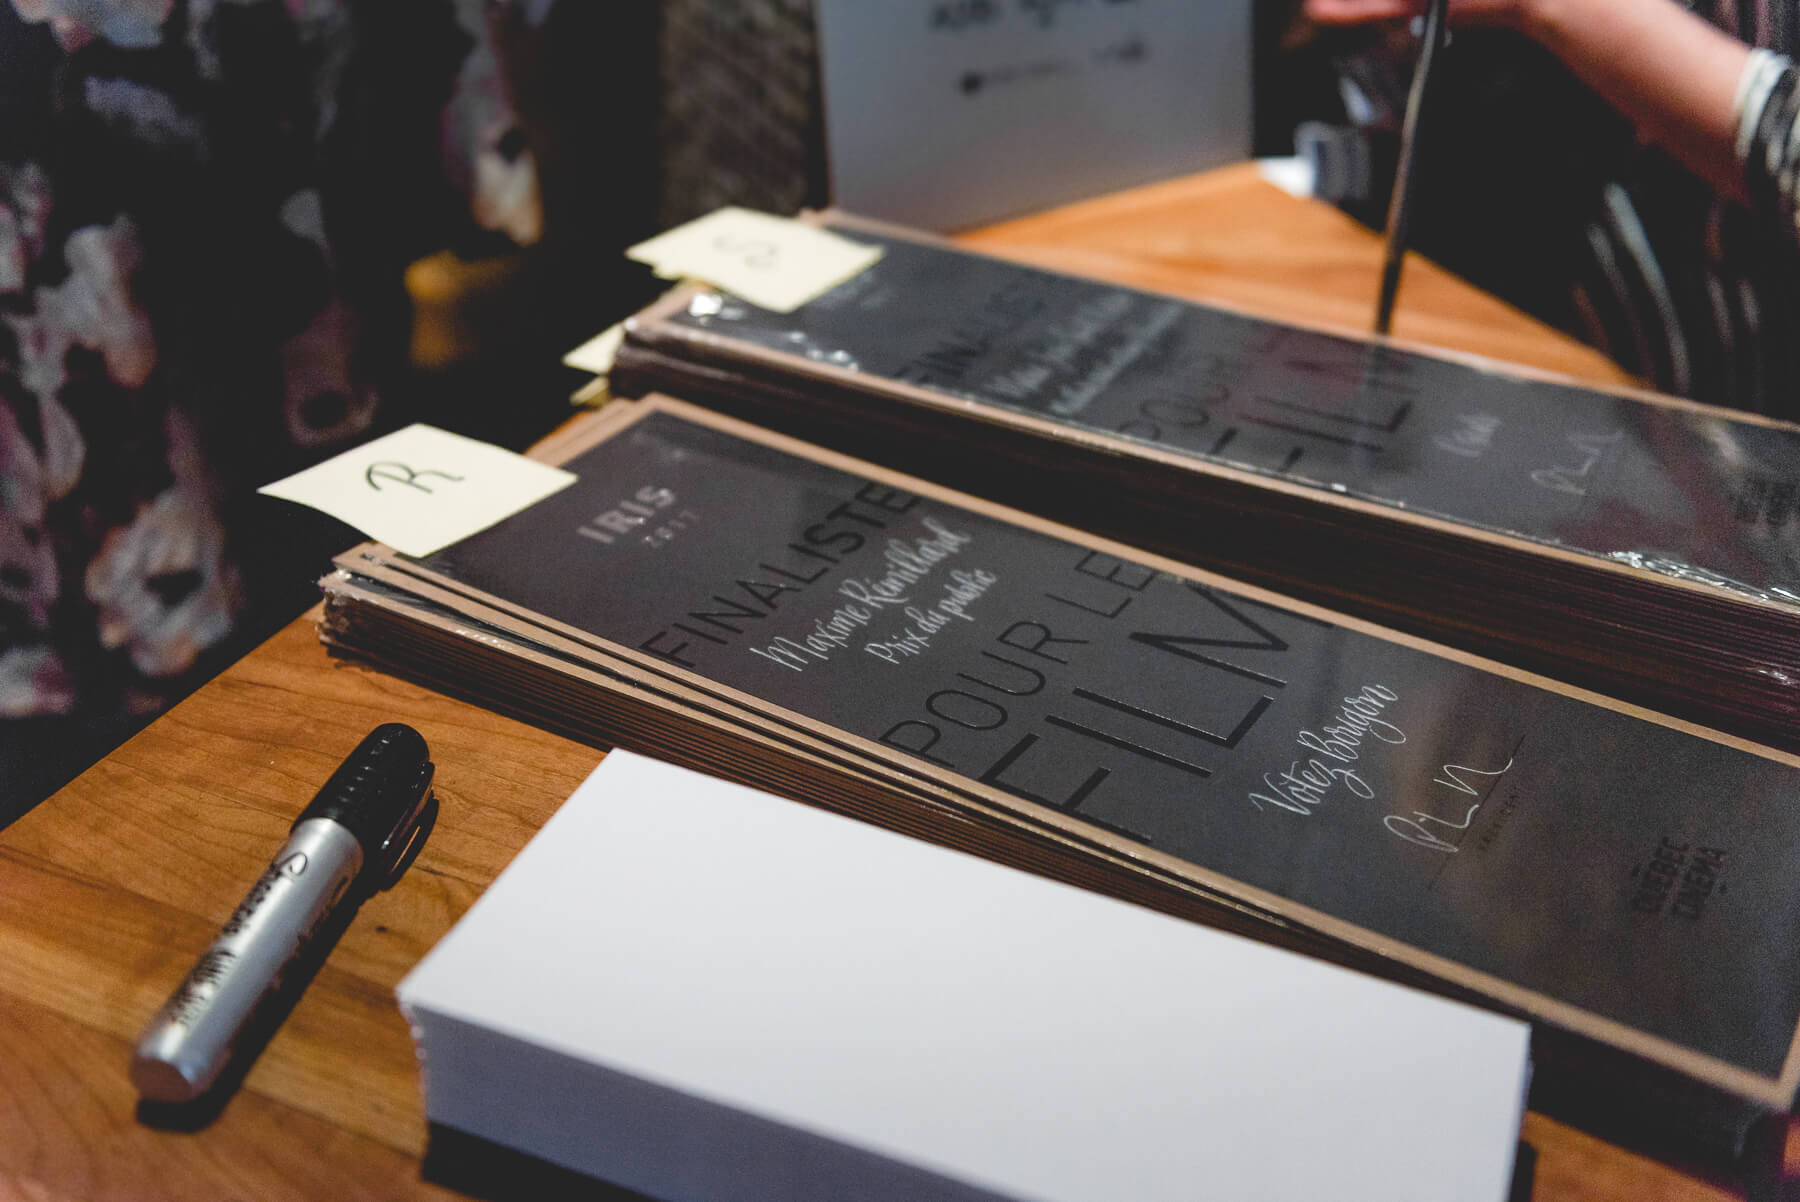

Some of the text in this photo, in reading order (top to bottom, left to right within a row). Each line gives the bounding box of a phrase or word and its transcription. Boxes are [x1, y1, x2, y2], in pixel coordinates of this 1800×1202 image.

[365, 459, 465, 494] R
[576, 485, 675, 544] IRIS
[637, 482, 922, 669] FINALISTE
[864, 568, 997, 665] Prix du public
[750, 604, 873, 672] Maxime
[878, 549, 1158, 768] POUR LE
[974, 577, 1332, 843] FILM
[1249, 760, 1375, 816] Votez
